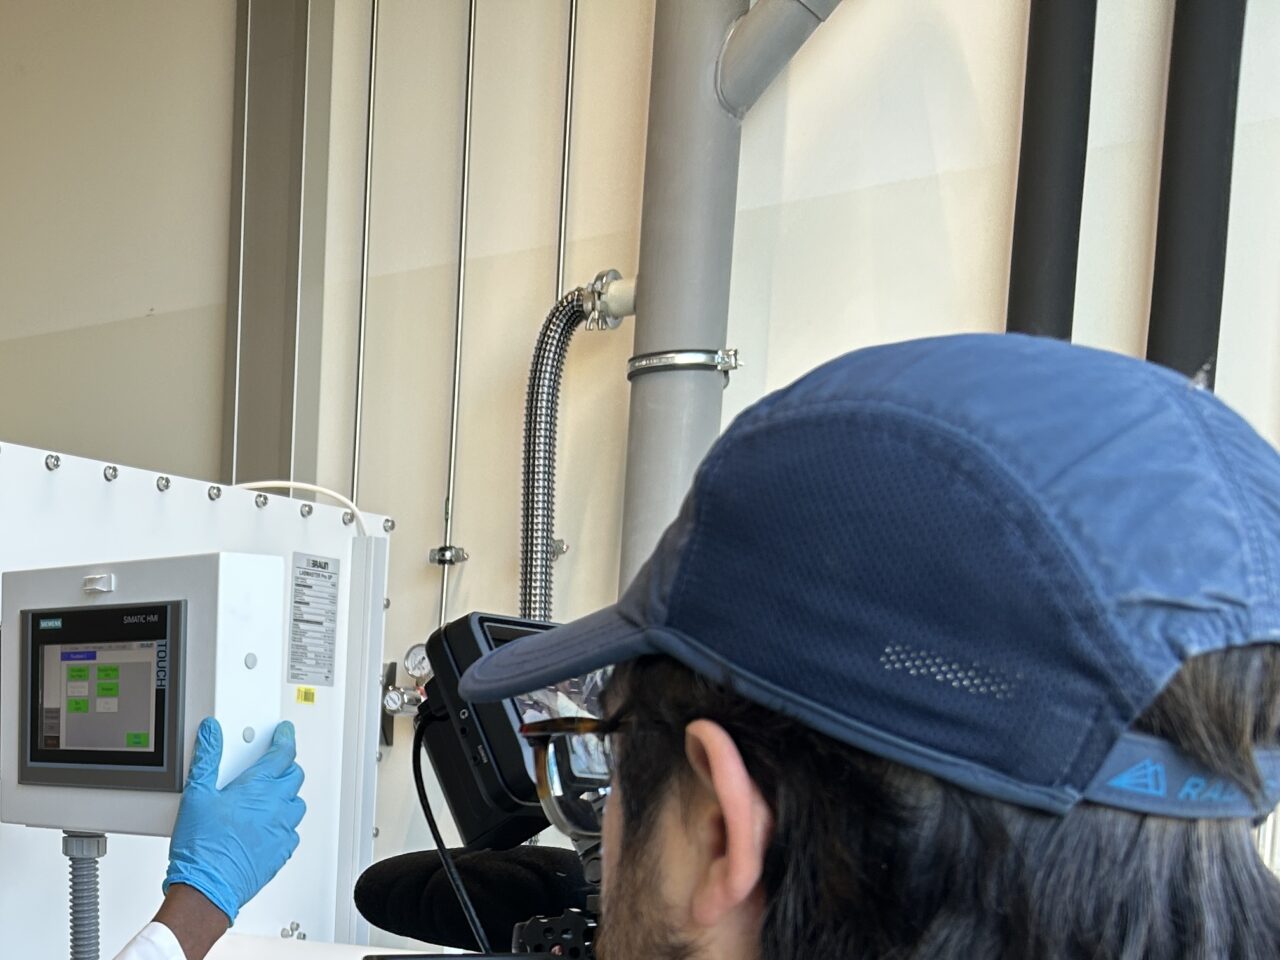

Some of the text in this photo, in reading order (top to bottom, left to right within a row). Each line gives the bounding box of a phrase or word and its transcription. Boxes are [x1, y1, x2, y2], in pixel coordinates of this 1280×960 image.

[123, 614, 158, 624] SIMATIC HMI
[156, 641, 167, 688] TOUCH
